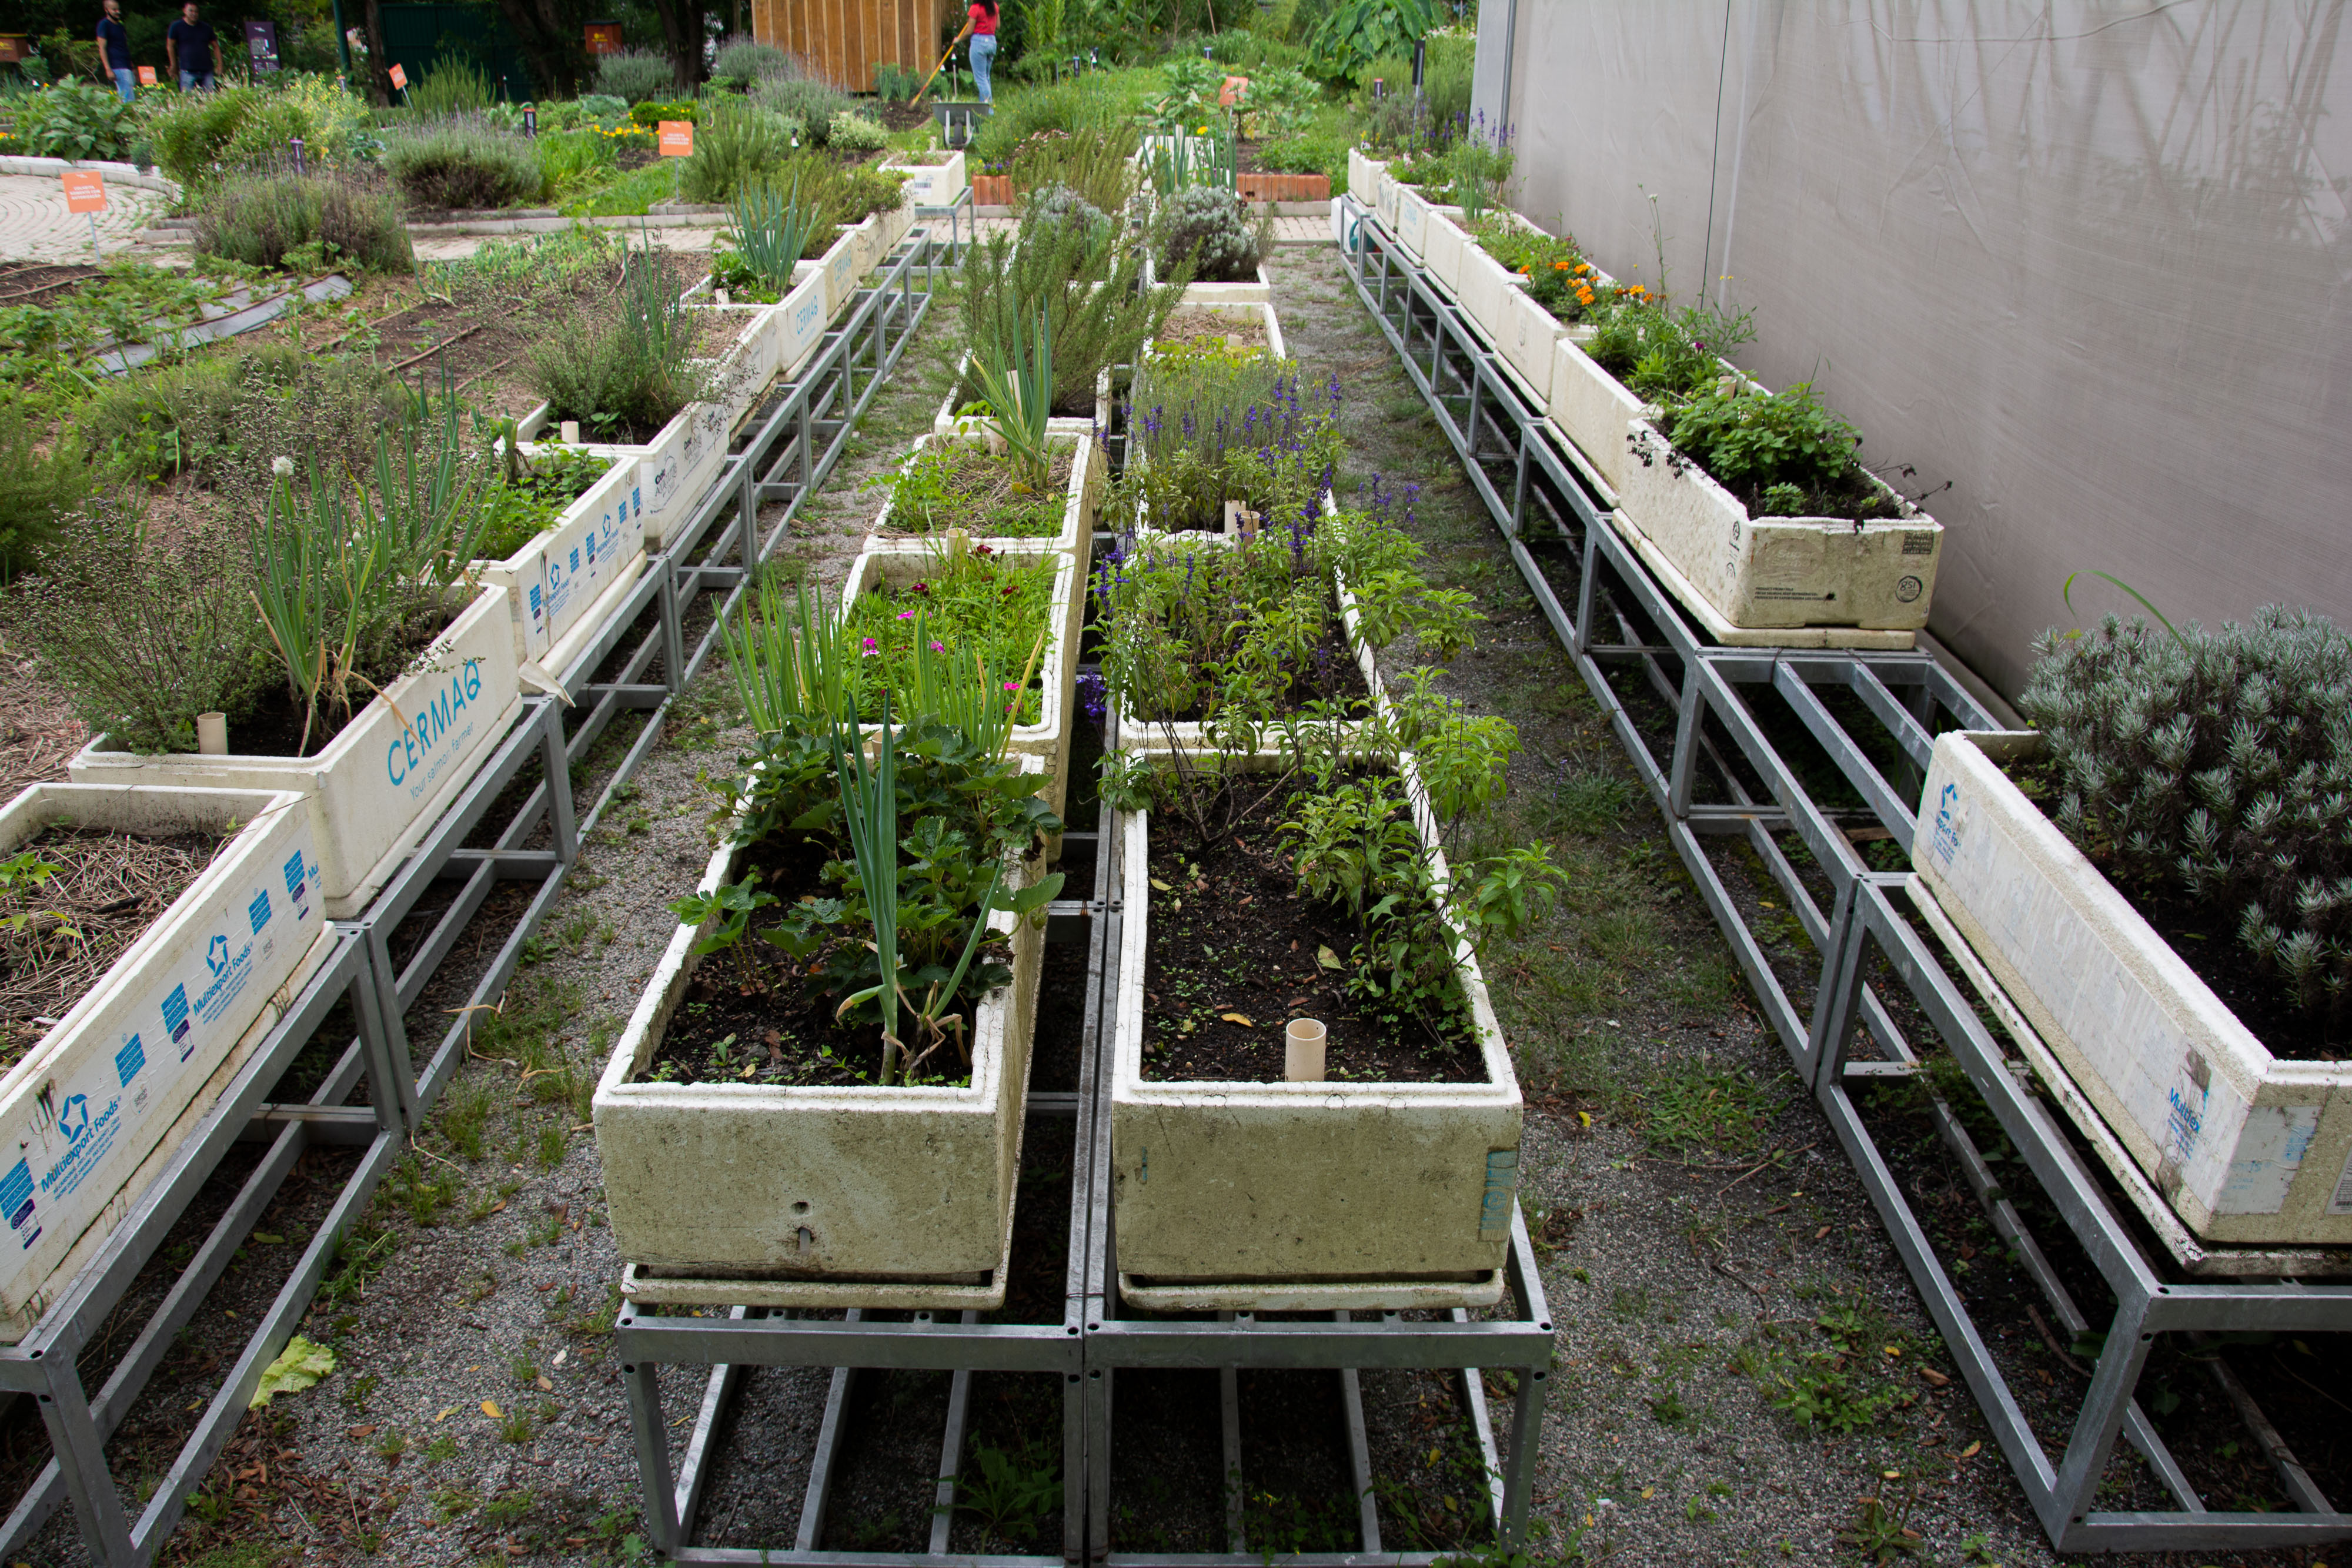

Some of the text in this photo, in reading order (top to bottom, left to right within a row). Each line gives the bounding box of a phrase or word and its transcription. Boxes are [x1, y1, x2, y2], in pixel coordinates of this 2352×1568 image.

[796, 295, 818, 335] CERMAQ
[388, 658, 481, 785] CERMAQ
[410, 721, 473, 801] Your salmon farmer
[193, 966, 232, 1016] Multiexport
[41, 1128, 94, 1193] Multiexport
[4, 1176, 31, 1208] ATLANTIC
